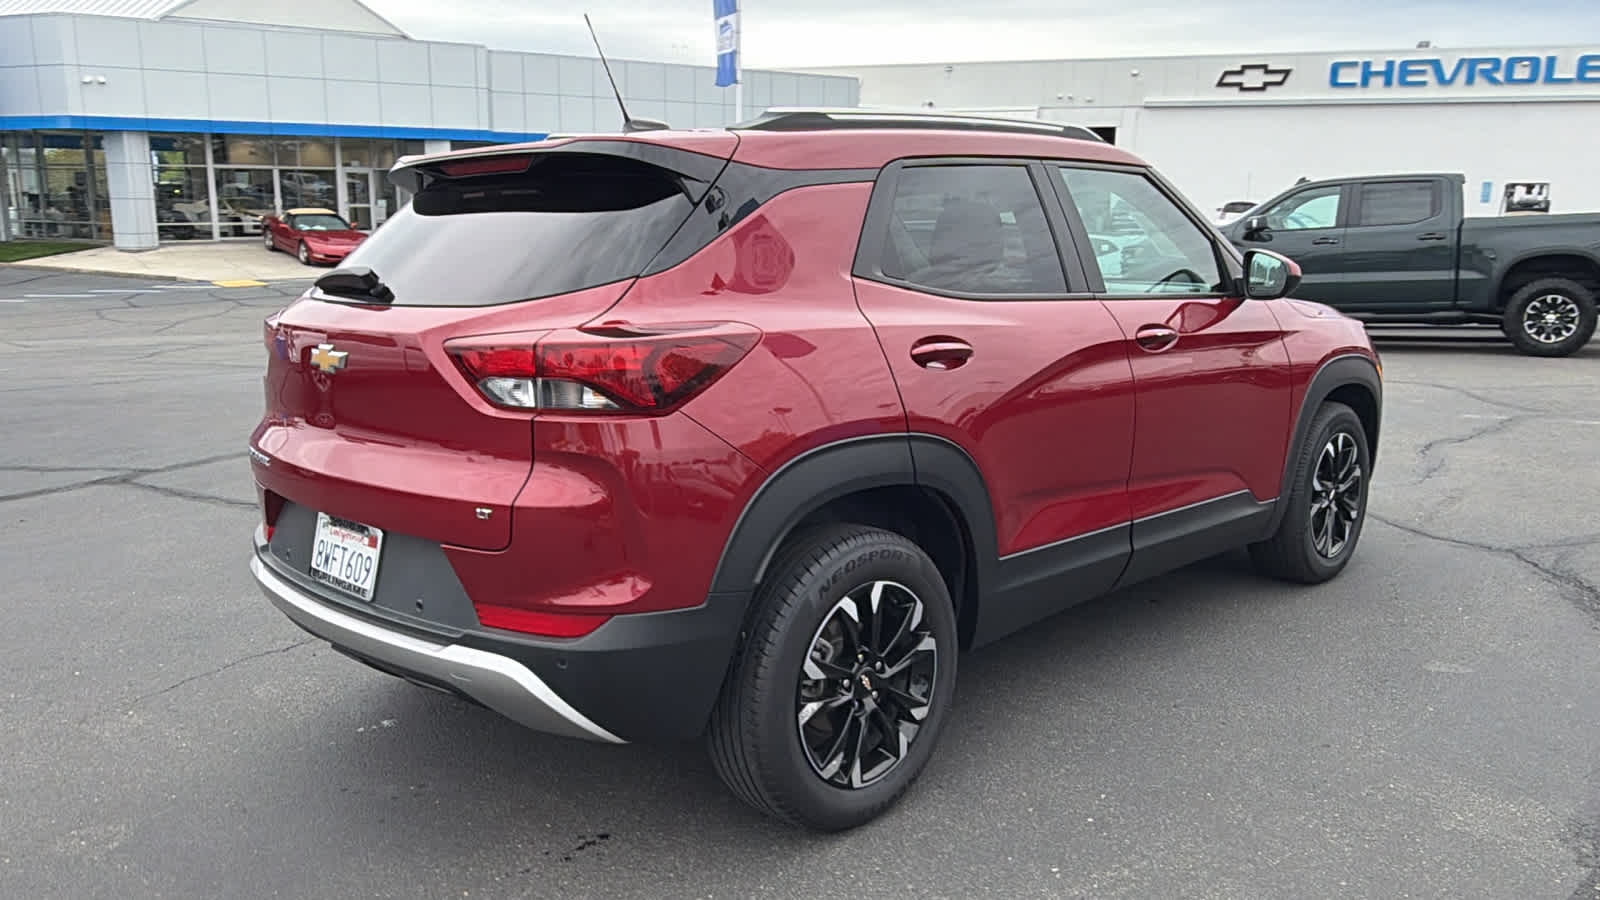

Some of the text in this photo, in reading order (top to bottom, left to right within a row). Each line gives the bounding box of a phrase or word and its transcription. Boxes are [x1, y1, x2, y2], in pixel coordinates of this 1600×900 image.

[1329, 55, 1600, 88] CHEVROLE
[315, 539, 373, 586] 8WFT609
[818, 548, 914, 599] NEOSPORT
